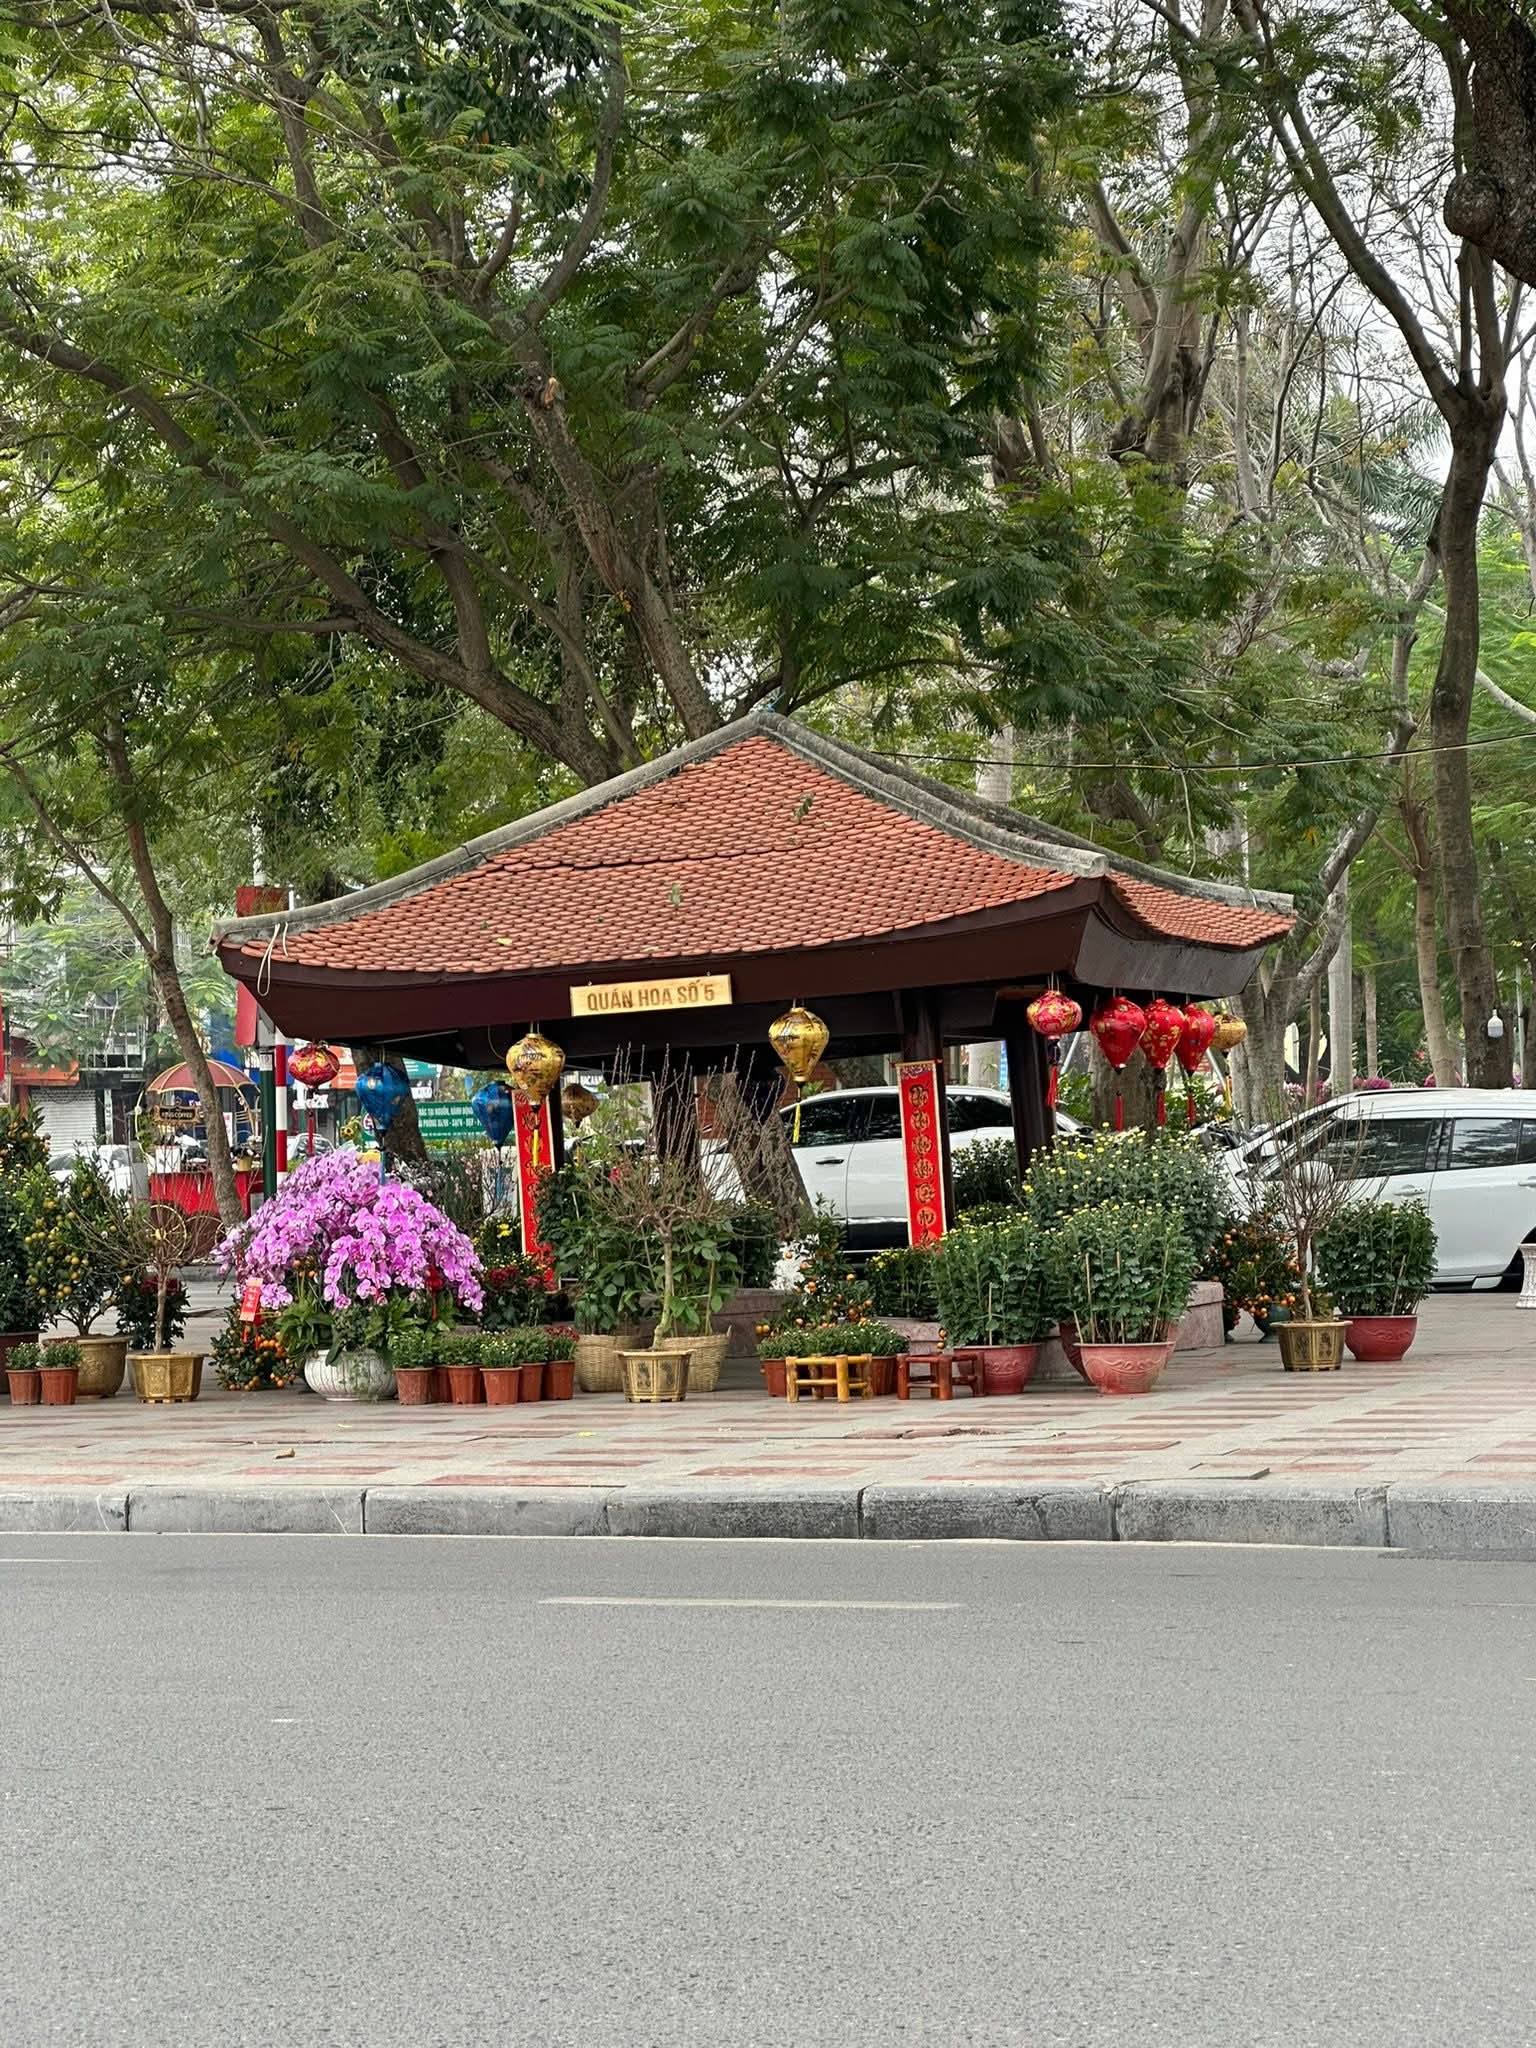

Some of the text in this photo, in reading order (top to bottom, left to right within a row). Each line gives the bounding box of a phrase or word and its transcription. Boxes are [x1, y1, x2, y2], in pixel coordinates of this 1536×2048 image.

[587, 979, 715, 1011] QUÁN HOA SỐ 5
